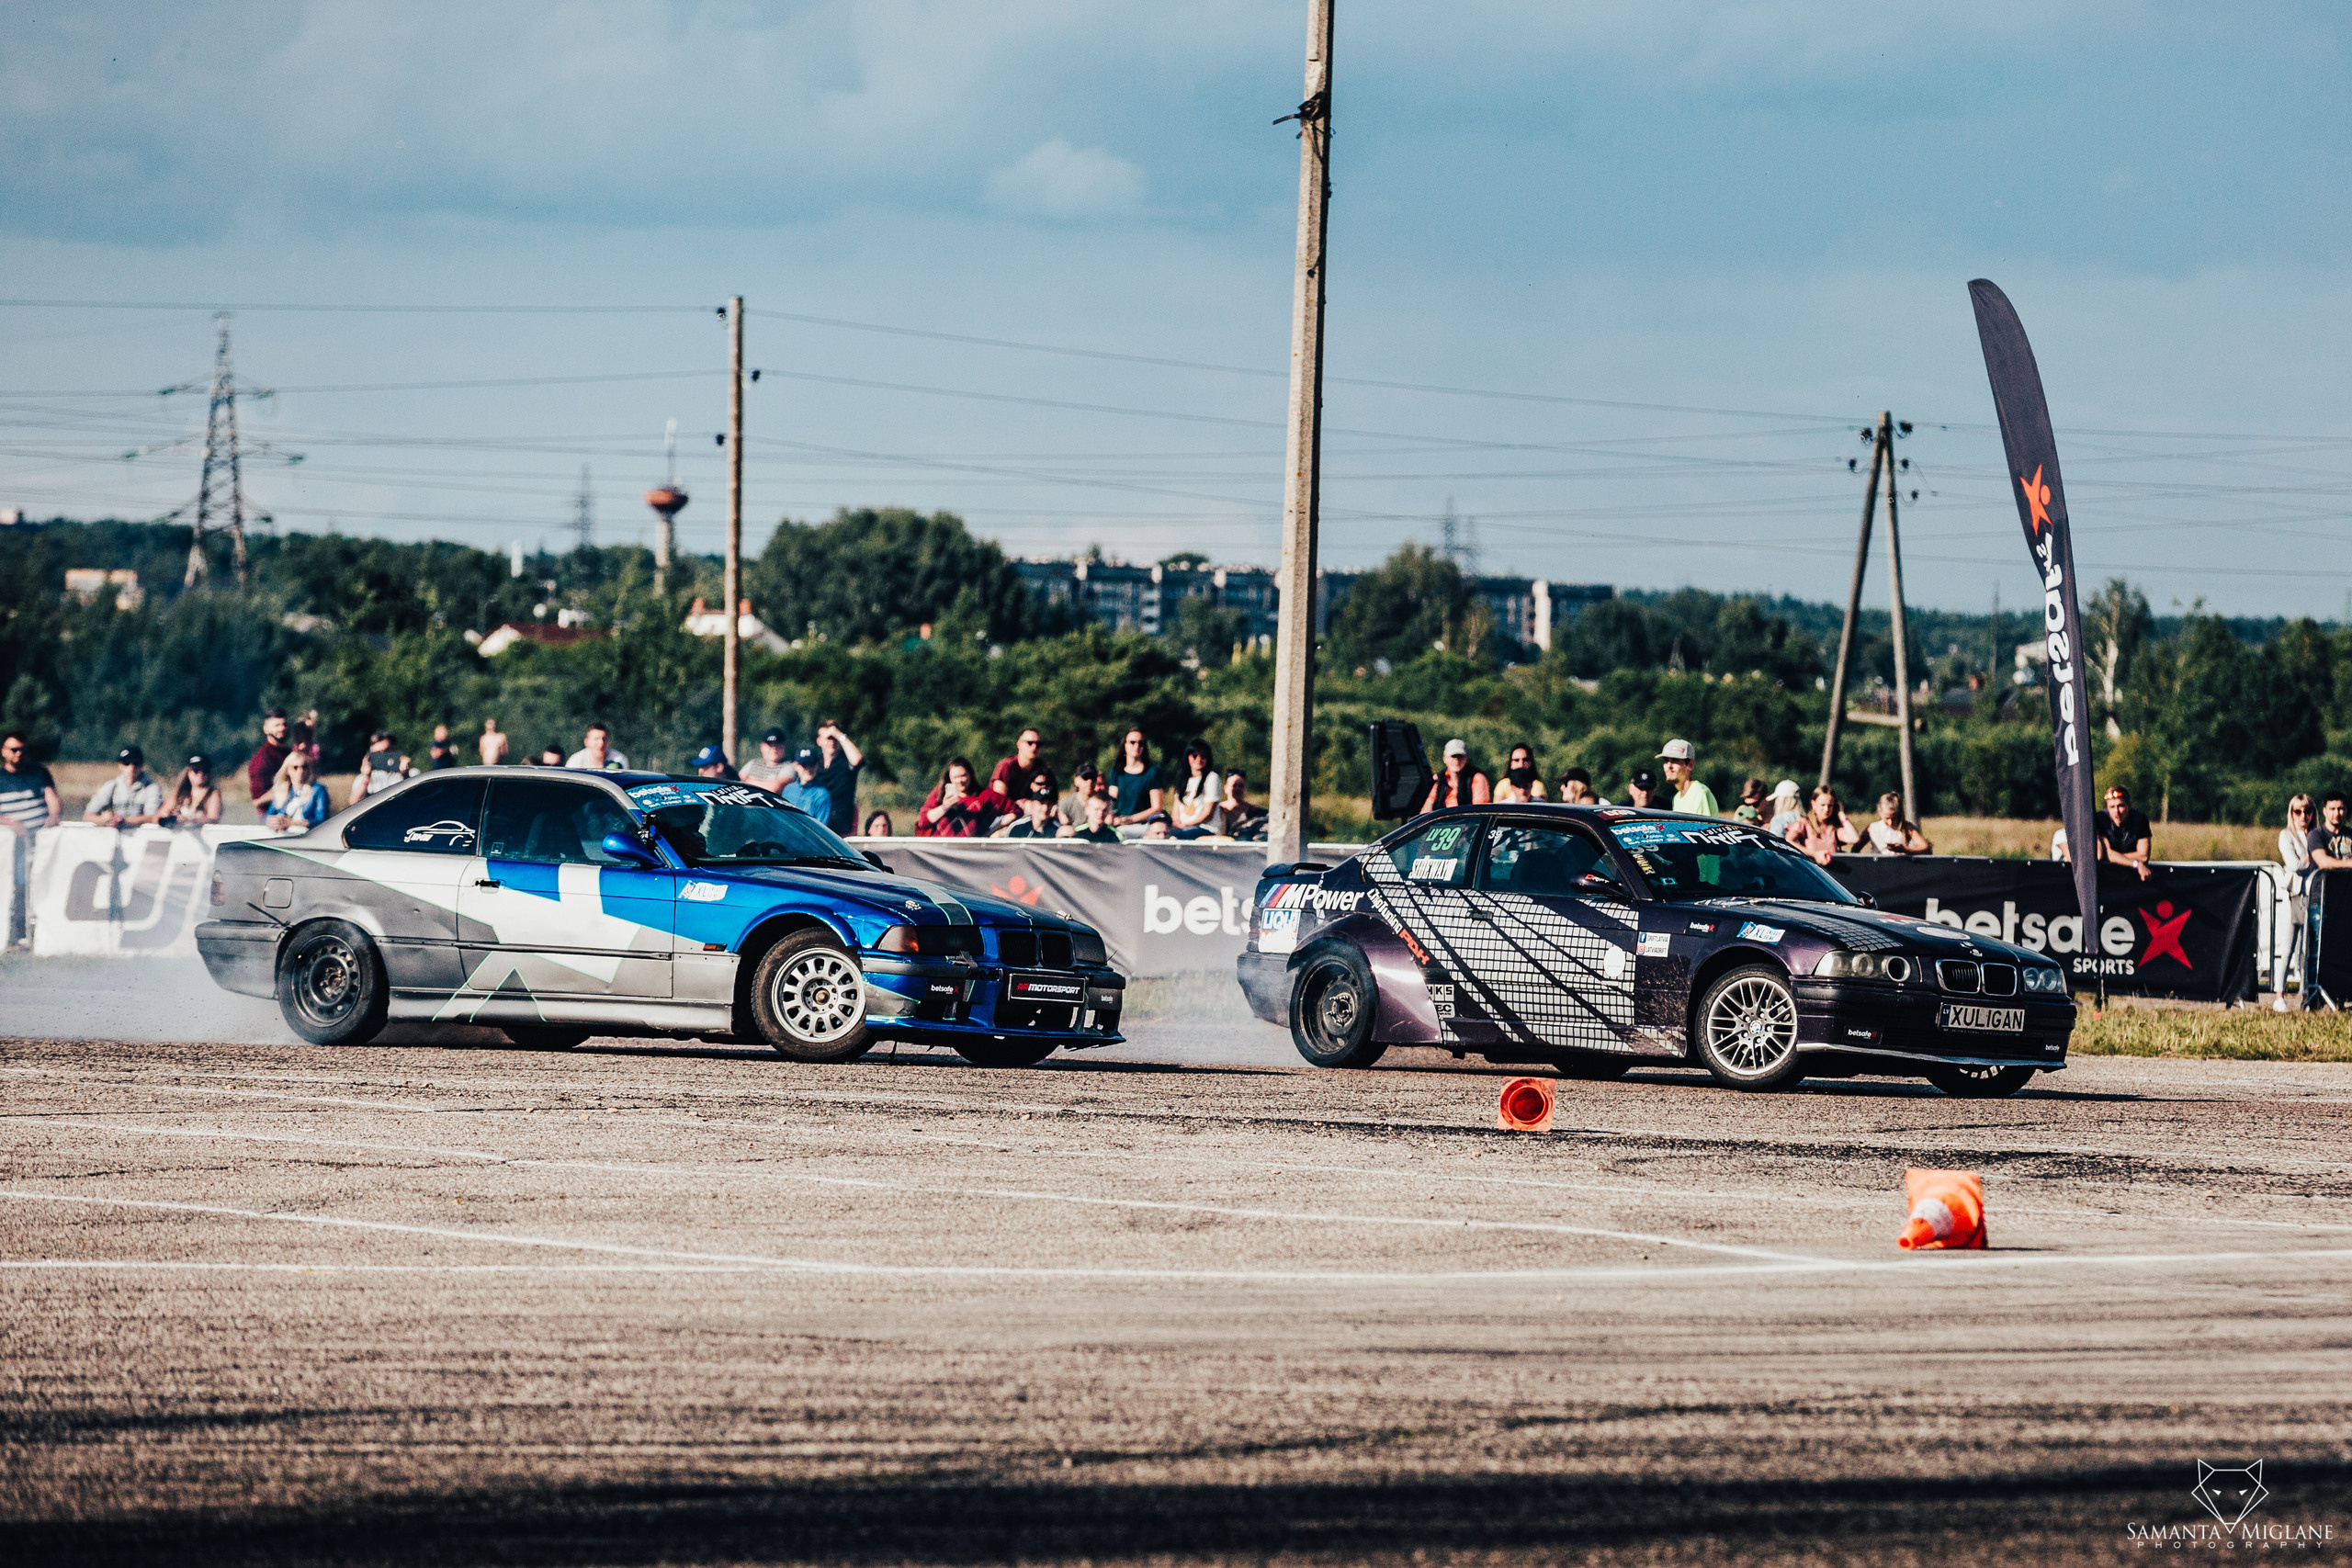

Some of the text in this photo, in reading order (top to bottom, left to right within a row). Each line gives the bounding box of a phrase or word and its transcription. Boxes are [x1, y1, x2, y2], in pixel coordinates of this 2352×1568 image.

[1431, 828, 1461, 851] 39
[1681, 830, 1765, 849] DRIFT
[2073, 957, 2134, 975] SPORTS
[931, 984, 954, 992] betsafe
[1951, 1007, 2023, 1029] XULIGAN
[1848, 1029, 1871, 1037] betsafe
